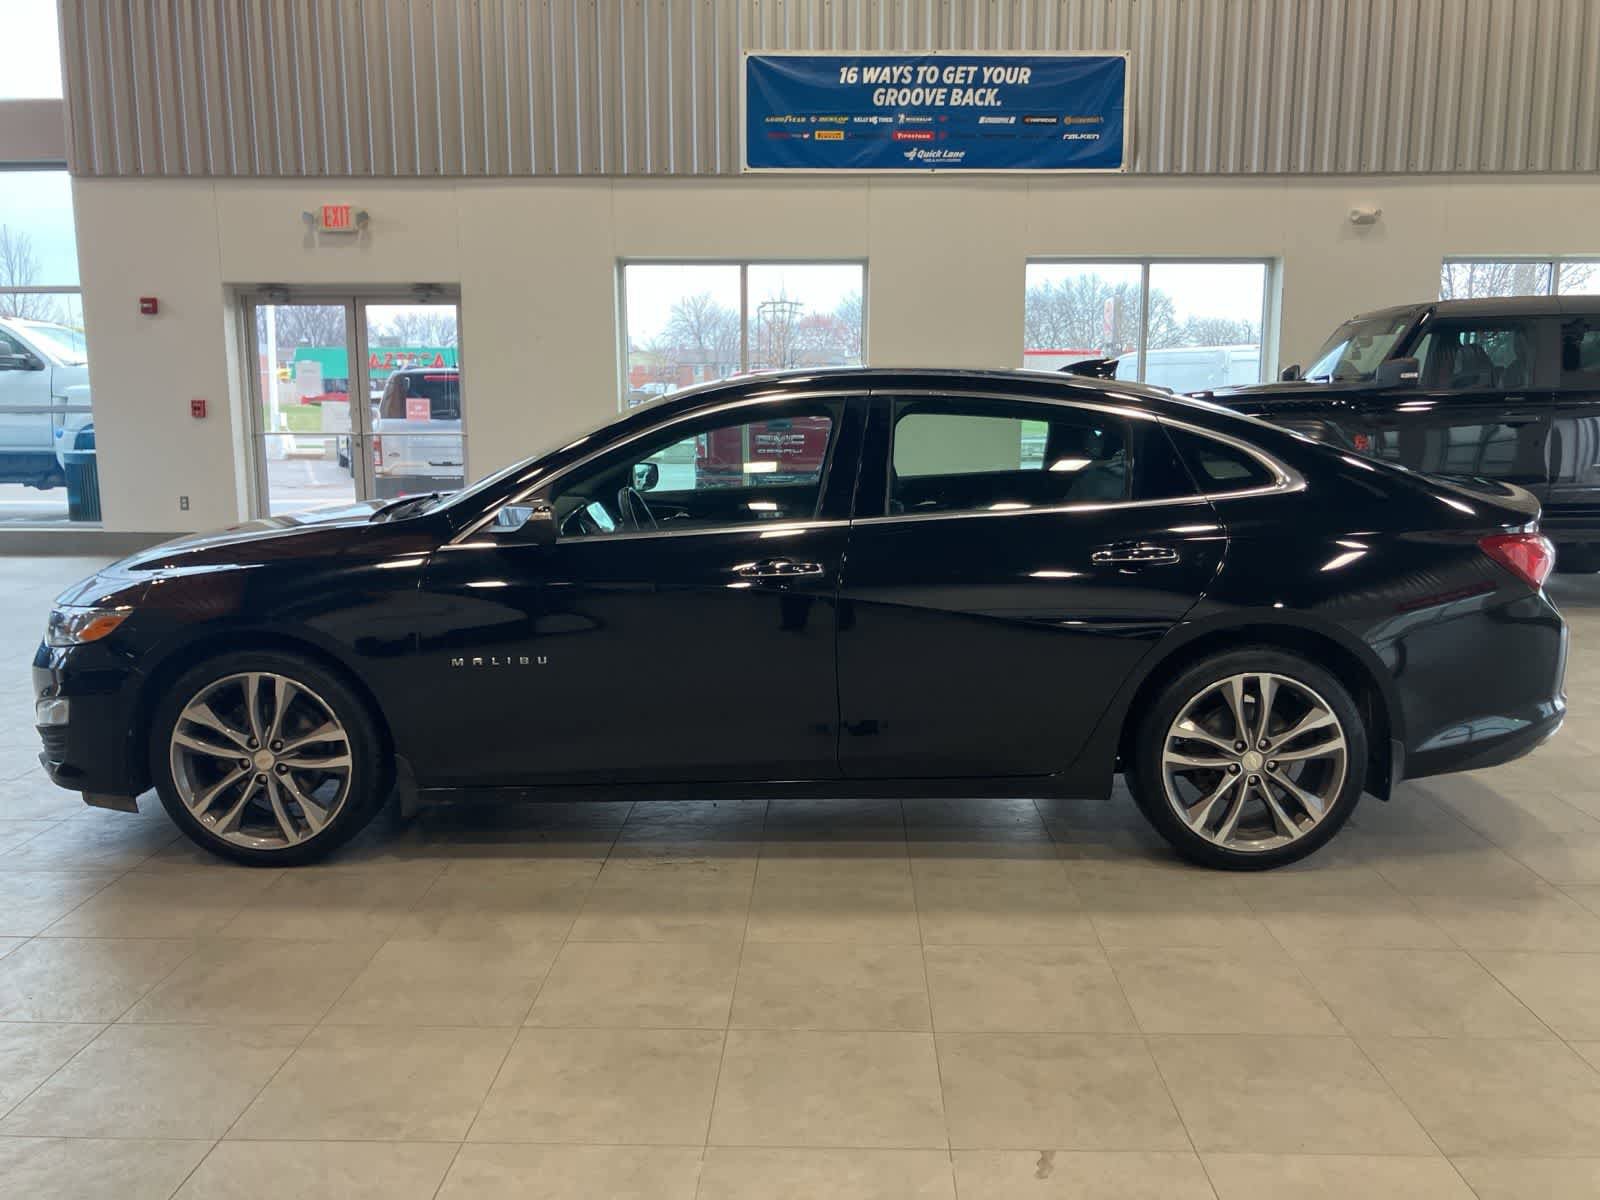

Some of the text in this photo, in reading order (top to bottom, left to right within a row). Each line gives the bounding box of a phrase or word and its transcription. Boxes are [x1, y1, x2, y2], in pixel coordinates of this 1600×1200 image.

[839, 66, 1031, 84] 16 WAYS TO GET YOUR
[873, 88, 1002, 106] GROOVE BACK.
[917, 149, 966, 159] Quick Lane
[323, 205, 350, 229] EXIT
[451, 656, 547, 667] MALIBU
